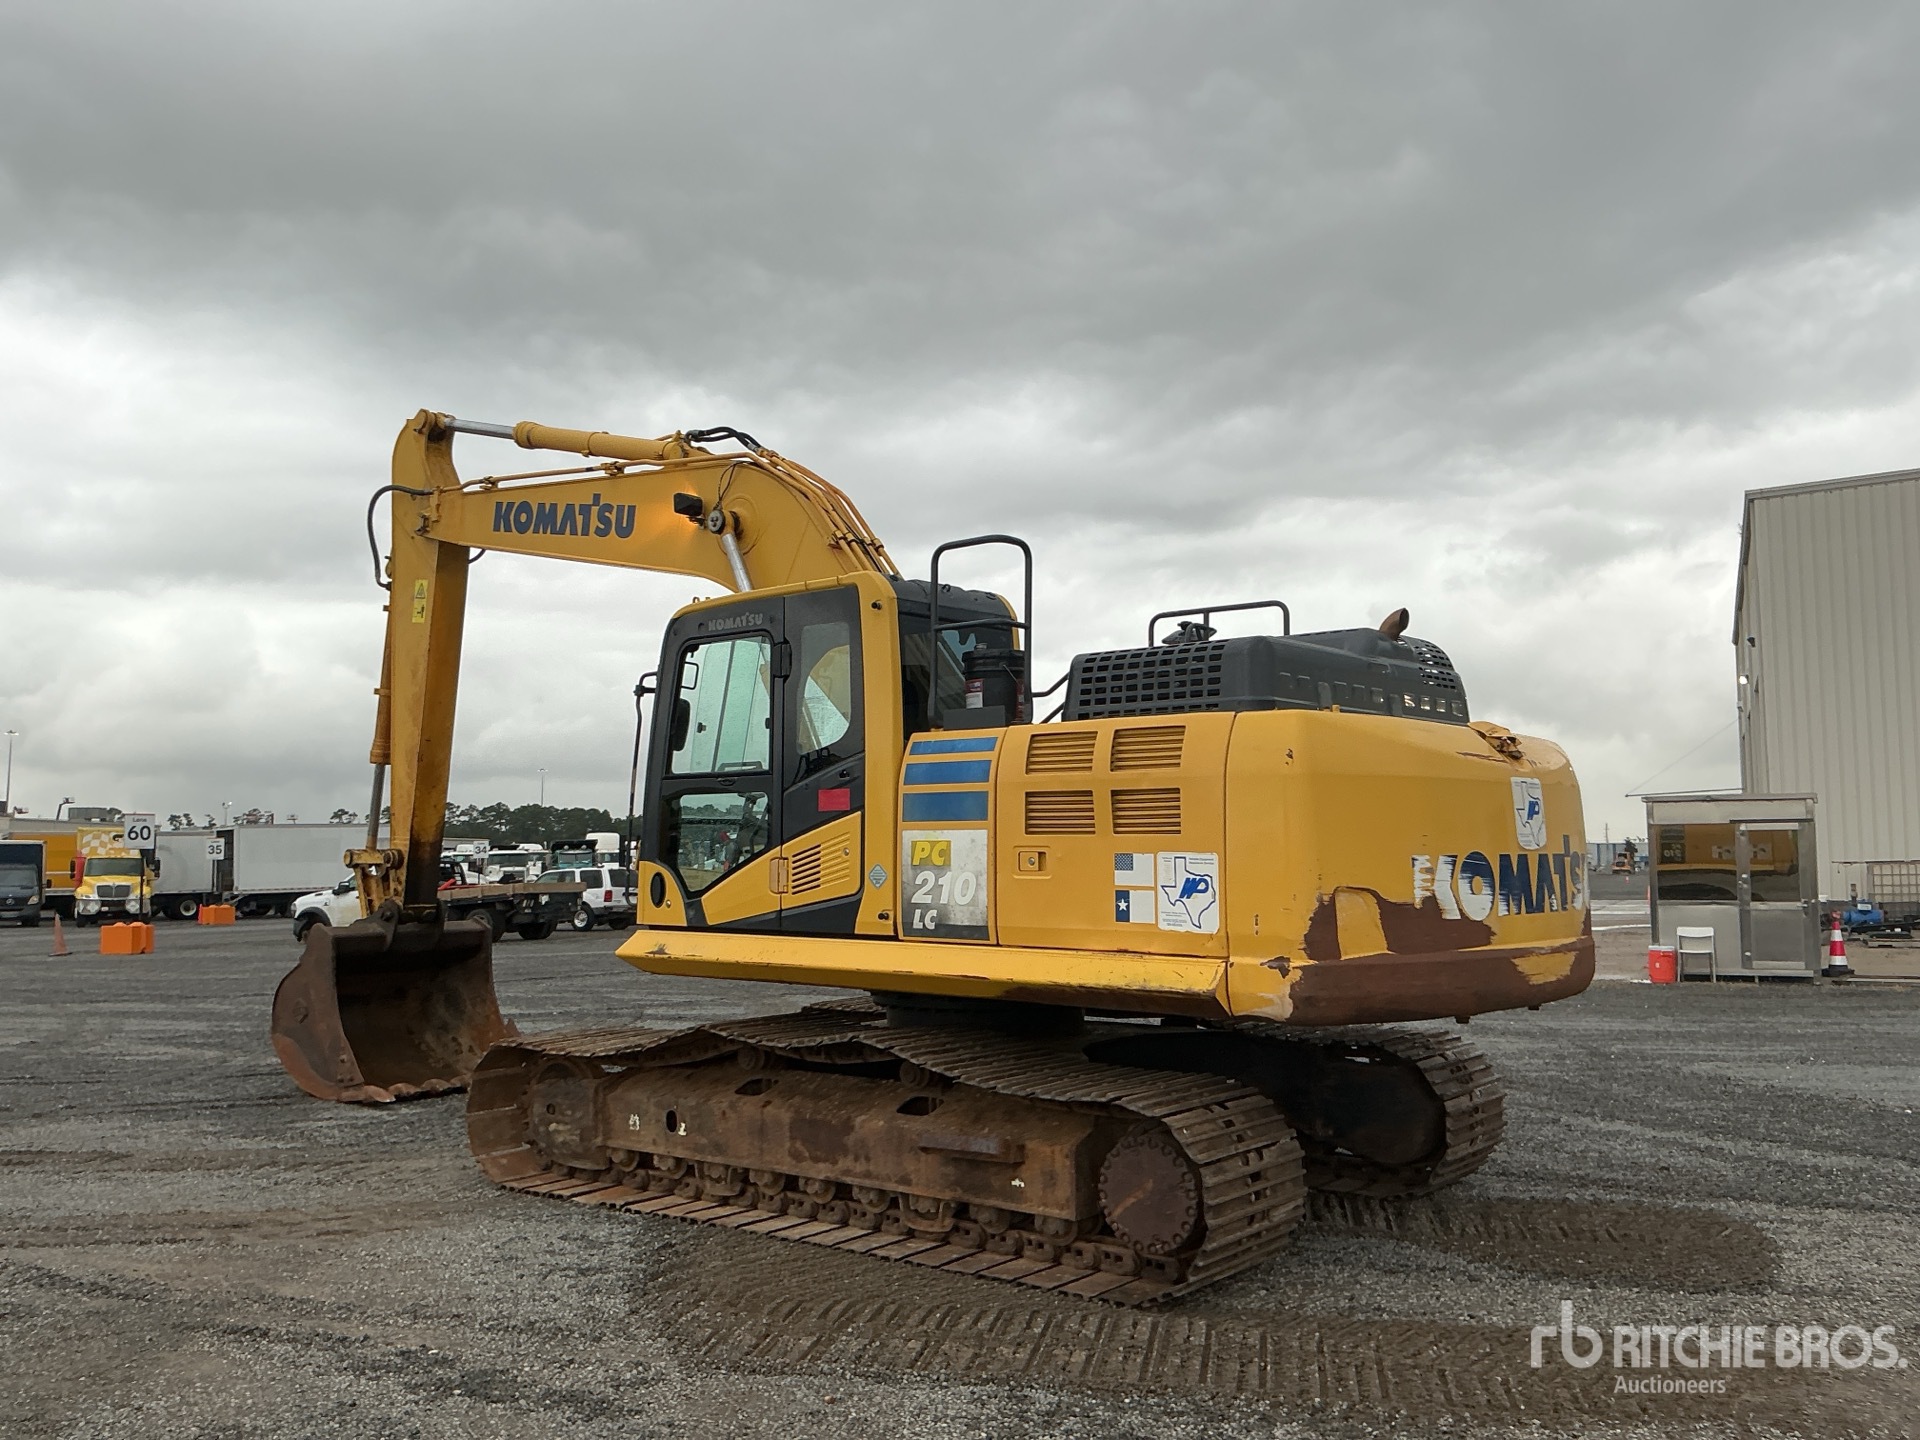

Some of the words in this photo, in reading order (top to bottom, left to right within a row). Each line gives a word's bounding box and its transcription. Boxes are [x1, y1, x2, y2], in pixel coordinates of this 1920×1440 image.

[493, 493, 637, 539] KOMATSU
[708, 611, 764, 632] KOMATSU
[127, 825, 151, 841] 60
[207, 844, 223, 855] 35
[474, 845, 487, 855] 34
[912, 841, 948, 866] PC
[911, 870, 977, 906] 210
[1411, 834, 1588, 921] KOMATS
[912, 909, 938, 930] LC
